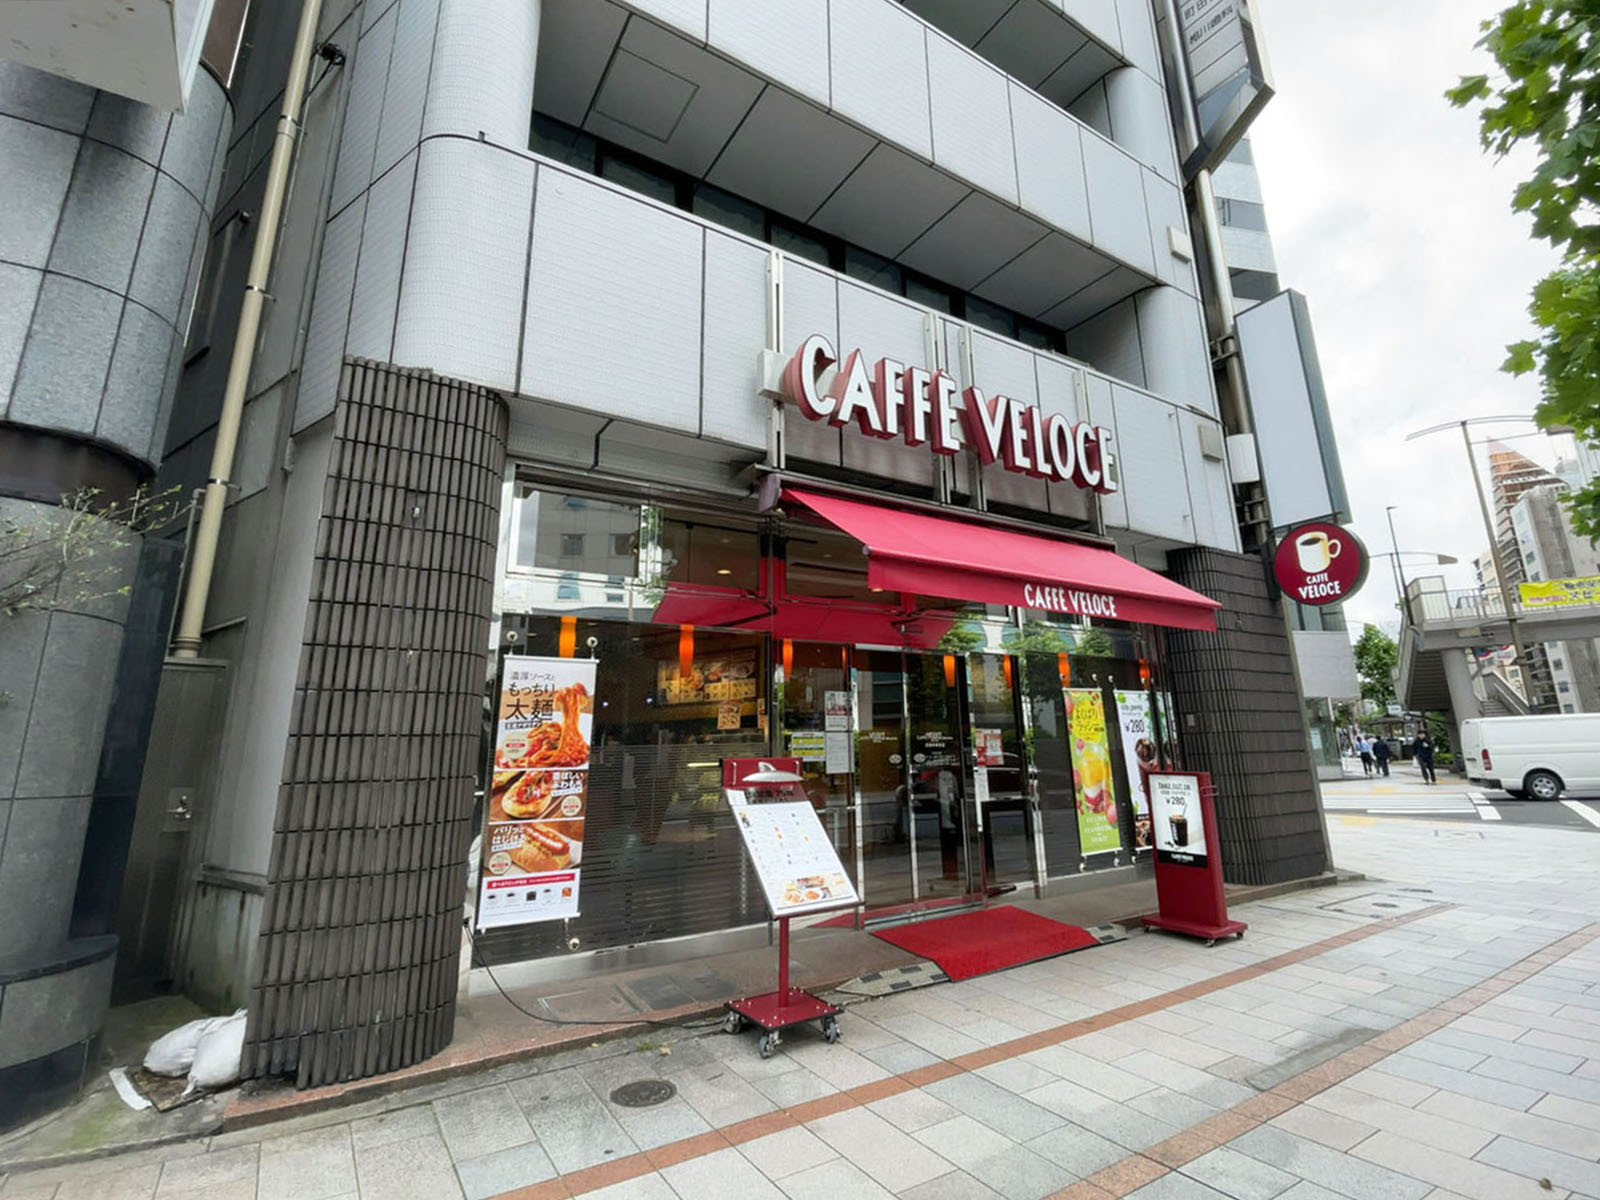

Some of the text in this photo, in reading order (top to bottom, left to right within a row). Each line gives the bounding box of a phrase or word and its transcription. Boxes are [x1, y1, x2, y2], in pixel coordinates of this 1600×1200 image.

[968, 386, 1118, 493] VELOCE
[1298, 580, 1341, 600] VELOCE
[1068, 590, 1117, 617] VELOCE
[508, 681, 555, 698] もっちり
[505, 698, 554, 721] 太麺
